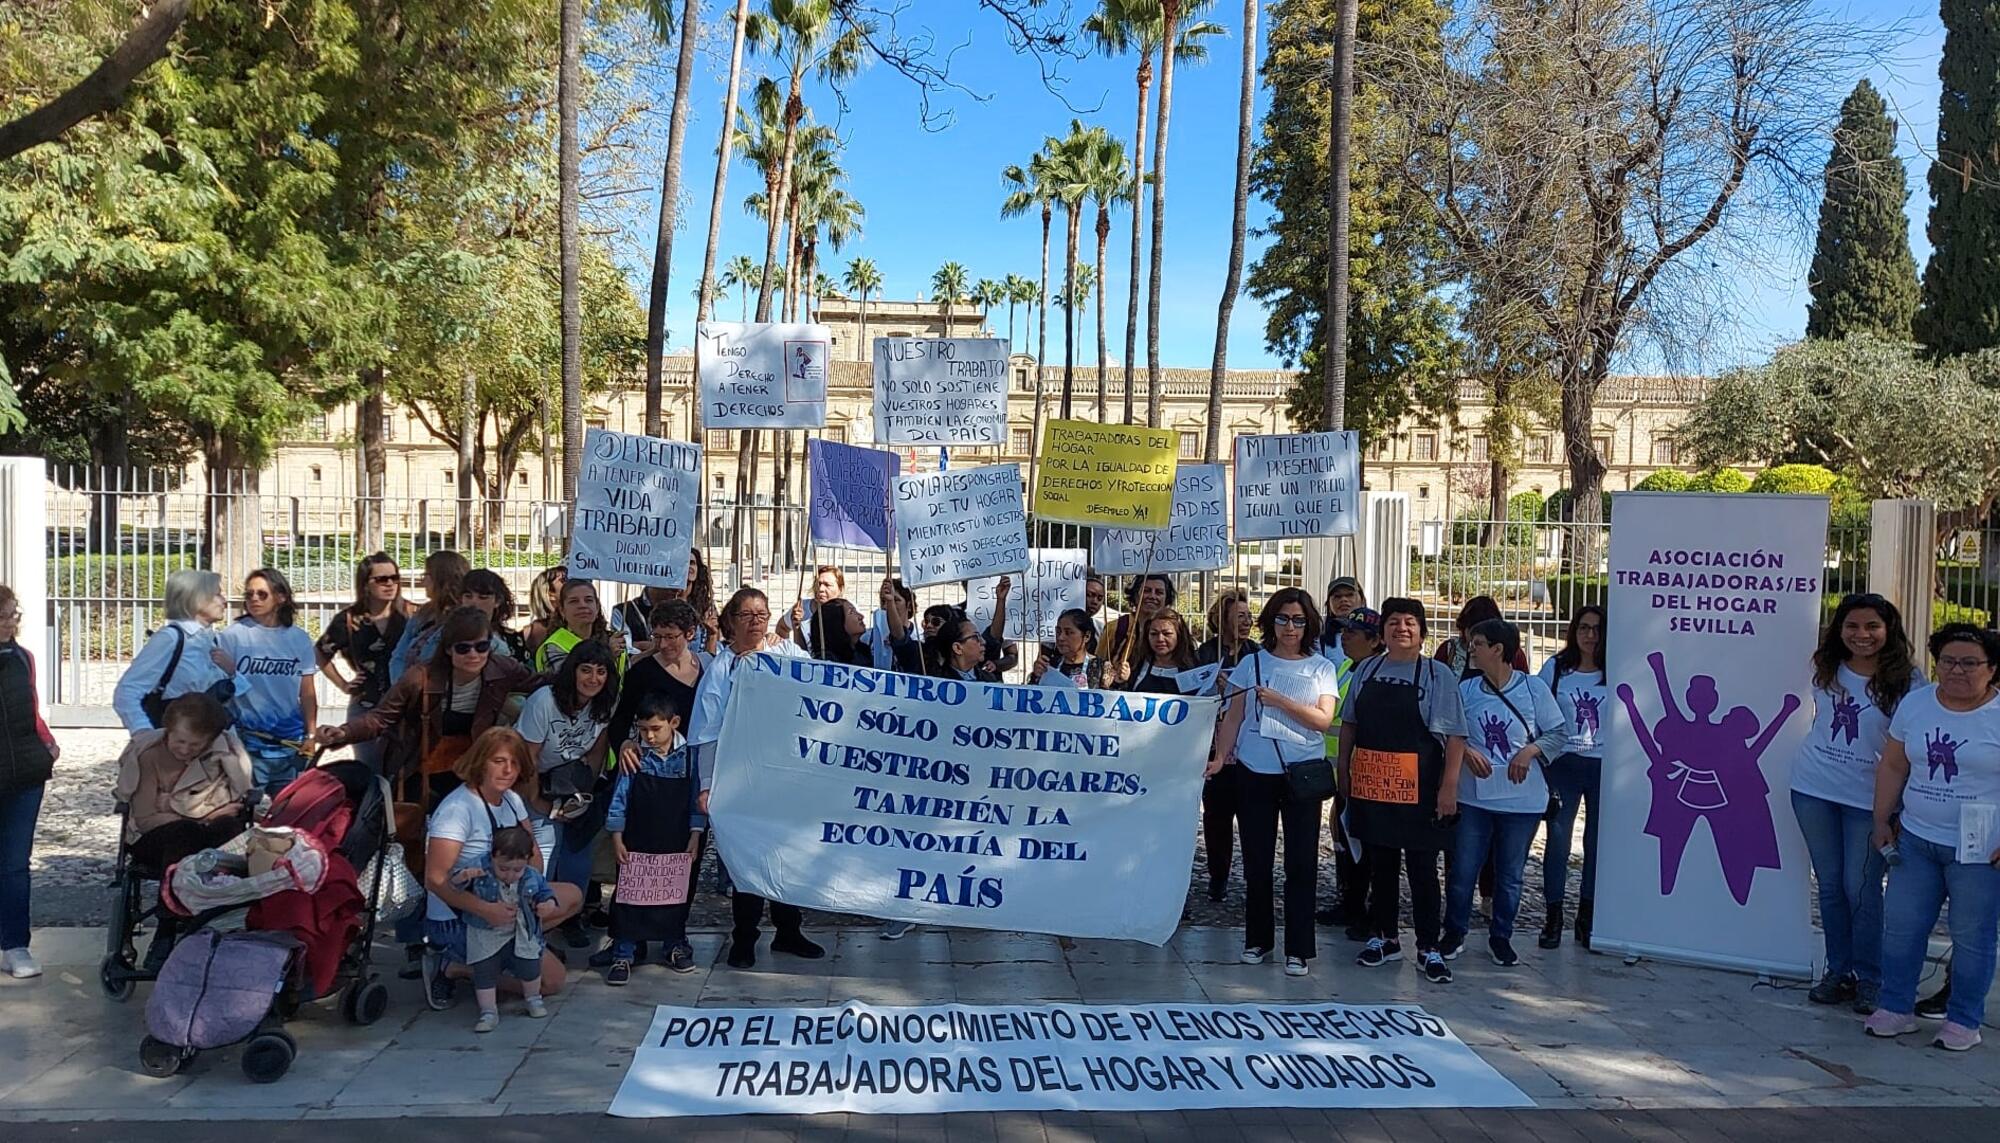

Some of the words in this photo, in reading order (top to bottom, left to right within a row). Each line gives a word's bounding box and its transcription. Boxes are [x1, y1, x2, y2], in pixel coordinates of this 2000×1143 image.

[712, 332, 747, 357] TENGO
[882, 341, 956, 361] NUESTRO
[724, 360, 775, 383] DERECHO
[946, 360, 1004, 378] TRABAJO
[719, 383, 726, 394] A
[731, 383, 769, 395] TENER
[882, 380, 897, 393] NO
[937, 380, 1000, 394] SOSTIENE
[713, 402, 785, 418] DERECHOS
[881, 400, 941, 412] VUESTROS
[947, 398, 997, 411] HOGARES
[947, 415, 961, 427] LA
[907, 429, 942, 441] DEL
[1051, 427, 1141, 446] TRABAJADORAS
[1148, 437, 1170, 449] DEL
[1246, 438, 1266, 458] MI
[1274, 435, 1330, 455] TIEMPO
[1340, 432, 1349, 450] Y
[594, 432, 698, 473] DERECHO
[1052, 443, 1095, 456] HOGAR
[1046, 457, 1069, 470] POR
[1073, 460, 1090, 472] LA
[1096, 462, 1151, 474] IGUALDAD
[1155, 464, 1169, 474] DE
[1267, 455, 1336, 478] PRESENCIA
[588, 464, 597, 480] A
[604, 466, 645, 486] TENER
[653, 474, 679, 493] UNA
[899, 479, 925, 500] SOY
[928, 476, 941, 496] LA
[943, 468, 1021, 493] RESPONSABLE
[1042, 476, 1102, 489] DERECHOS
[1108, 480, 1117, 492] Y
[1175, 476, 1213, 493] SAS
[1237, 483, 1272, 498] TIENE
[1280, 481, 1299, 495] UN
[1310, 477, 1345, 495] PRECIO
[604, 487, 652, 512] VIDA
[670, 500, 677, 511] Y
[928, 503, 947, 517] DE
[949, 498, 969, 513] TU
[976, 488, 1016, 509] HOGAR
[1043, 491, 1070, 502] SOCIAL
[1132, 504, 1149, 521] YA!
[1170, 501, 1220, 517] ADAS
[1245, 502, 1284, 518] IGUAL
[1295, 500, 1322, 514] QUE
[1330, 498, 1344, 512] EL
[580, 508, 677, 538] TRABAJO
[908, 521, 966, 541] MIENTRAS
[983, 514, 996, 528] NO
[1170, 525, 1228, 542] FUERTE
[1280, 518, 1320, 535] TUYO
[616, 540, 651, 556] DIGNO
[950, 541, 968, 553] MIS
[972, 532, 1021, 550] DERECHOS
[575, 552, 599, 570] SIN
[608, 557, 674, 578] VIOLENCIA
[915, 564, 923, 580] Y
[932, 564, 945, 575] UN
[952, 558, 982, 574] PAGO
[986, 547, 1026, 567] JUSTO
[1122, 545, 1222, 567] EMPODERADA
[1648, 549, 1784, 569] ASOCIACIÓN
[1616, 570, 1817, 593] TRABAJADORAS/ES
[1652, 594, 1691, 610] DEL
[1696, 596, 1777, 614] HOGAR
[1010, 609, 1055, 621] AMBIO
[1669, 616, 1756, 635] SEVILLA
[237, 655, 301, 676] Outcast
[752, 652, 967, 706] NUESTRO
[984, 685, 1189, 726] TRABAJO
[796, 696, 843, 724] NO
[856, 706, 938, 742] SÓLO
[953, 724, 1120, 758] SOSTIENE
[798, 736, 970, 786] VUESTROS
[988, 766, 1148, 796] HOGARES,
[854, 786, 1016, 826] TAMBIÉN
[1024, 805, 1072, 826] LA
[819, 821, 1004, 857] ECONOMÍA
[1018, 837, 1088, 862] DEL
[894, 865, 1003, 909] PAÍS
[660, 1016, 735, 1048] POR
[740, 1015, 780, 1046] EL
[791, 1008, 1076, 1046] RECONOCIMIENTO
[1080, 1012, 1131, 1042] DE
[1130, 1010, 1265, 1041] PLENOS
[1258, 1008, 1446, 1040] DERECHOS
[717, 1054, 1002, 1097] TRABAJADORAS
[1009, 1055, 1083, 1092] DEL
[1082, 1055, 1221, 1092] HOGAR
[1211, 1056, 1244, 1090] Y
[1245, 1053, 1437, 1090] CUIDADOS
